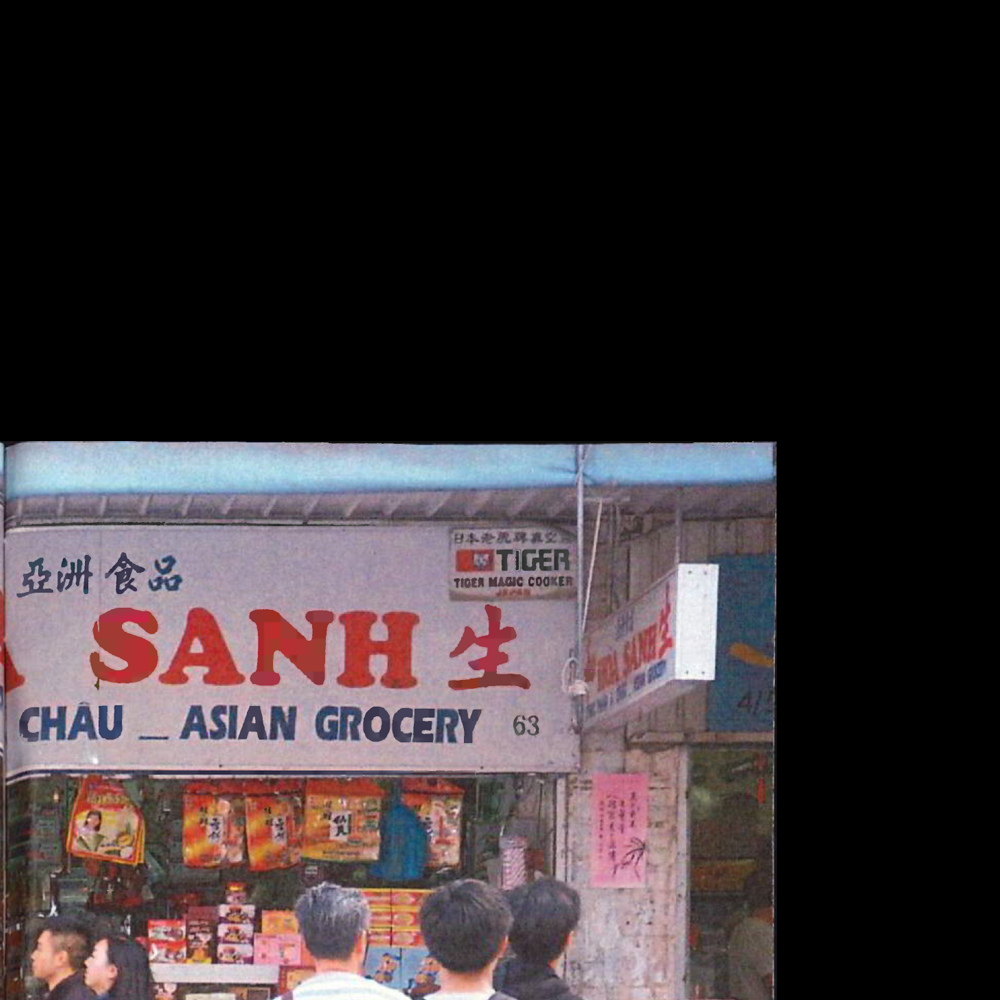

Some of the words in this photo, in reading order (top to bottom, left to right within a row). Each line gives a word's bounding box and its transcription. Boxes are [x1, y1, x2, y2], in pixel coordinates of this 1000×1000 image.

[496, 548, 571, 571] TIGER
[453, 577, 485, 588] TIGER
[488, 576, 523, 587] MAGIC
[528, 575, 574, 587] COOKER
[90, 606, 420, 689] SANH
[448, 604, 532, 690] 生
[180, 705, 297, 741] ASIAN
[315, 705, 481, 743] GROCERY
[513, 715, 540, 736] 63
